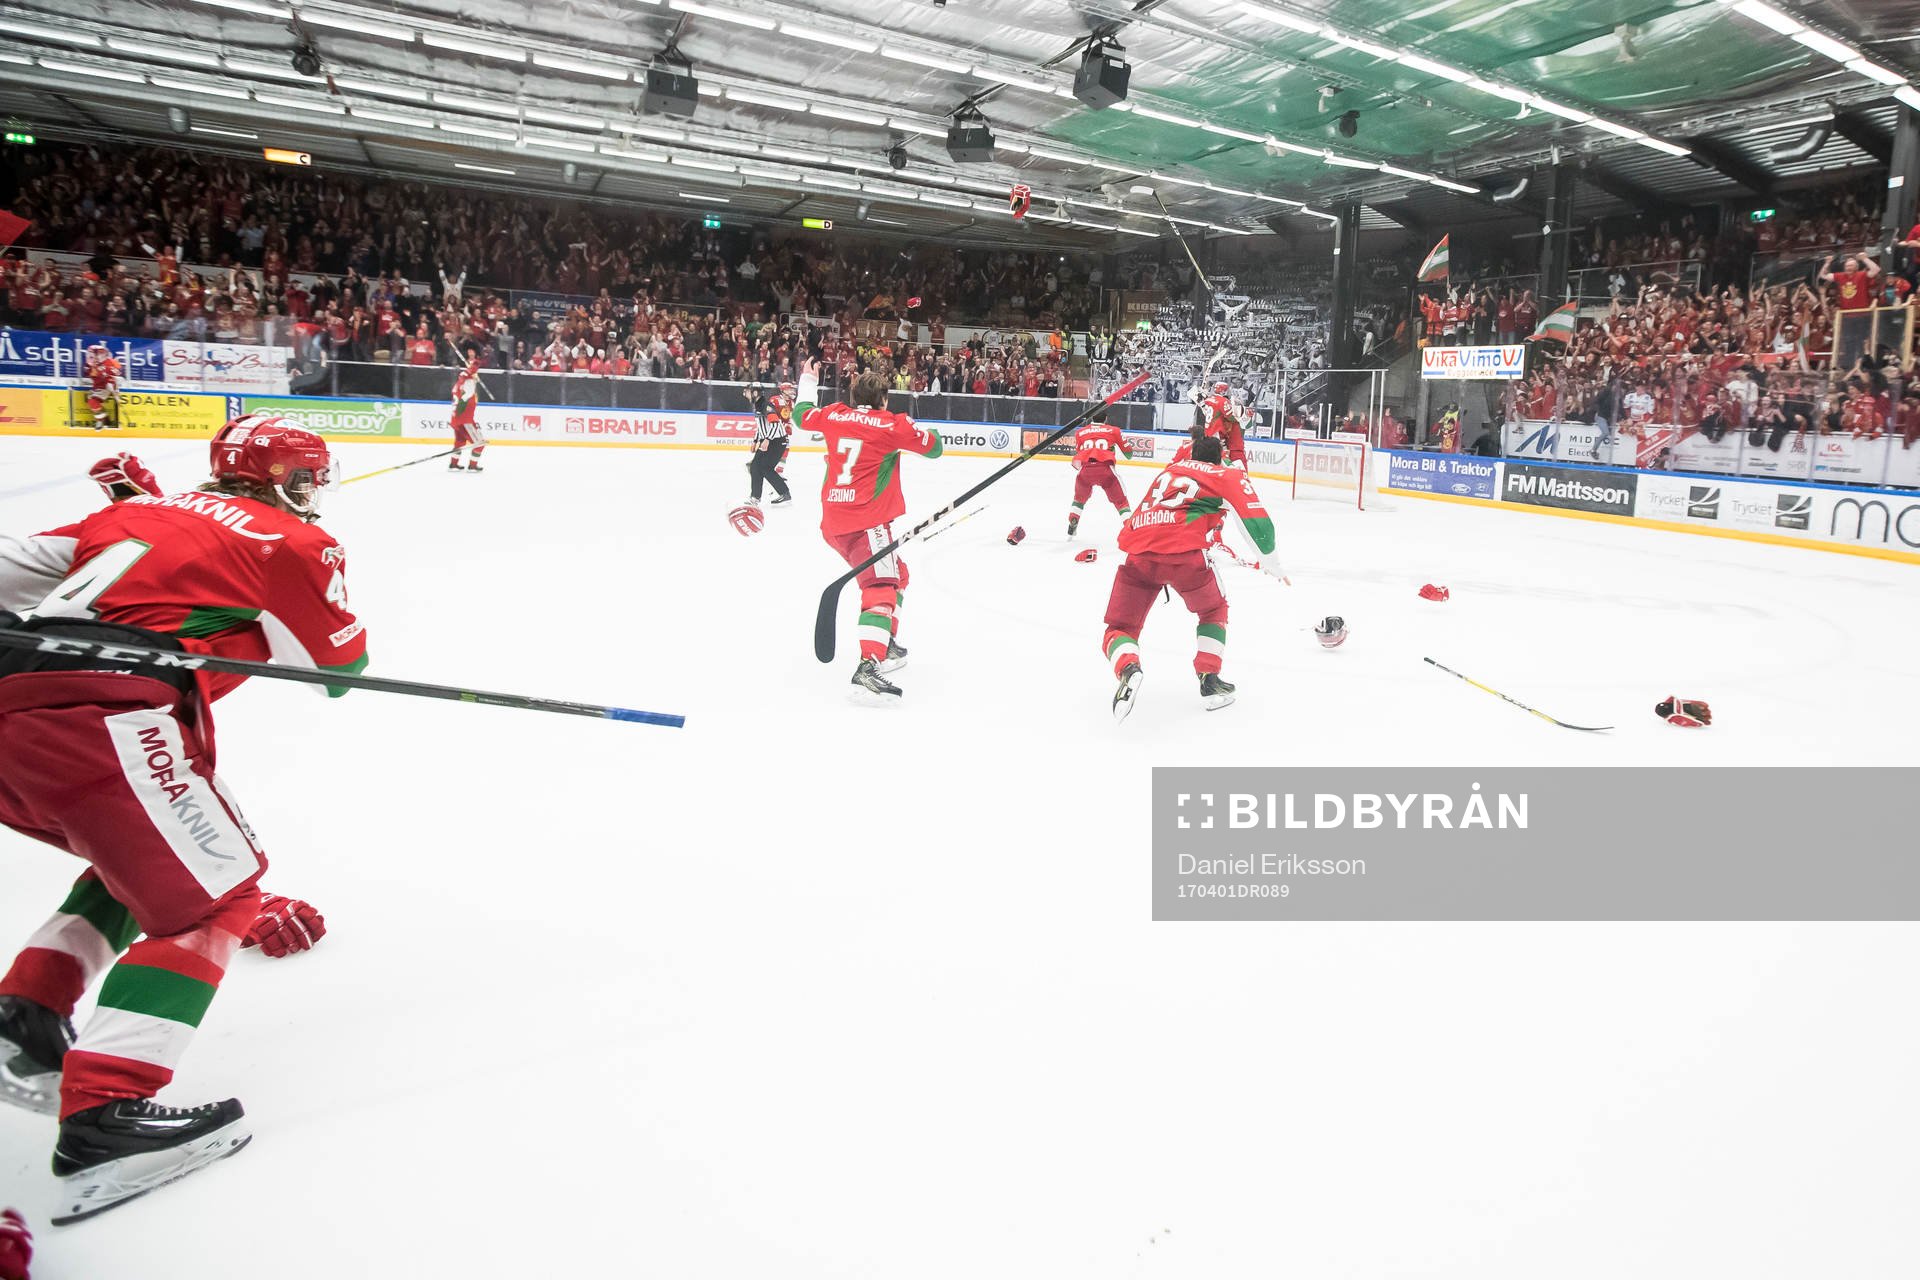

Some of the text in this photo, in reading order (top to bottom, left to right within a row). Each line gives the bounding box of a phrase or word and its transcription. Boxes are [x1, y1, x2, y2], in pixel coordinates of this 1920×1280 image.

[299, 154, 308, 164] C
[824, 221, 831, 229] D
[1127, 302, 1161, 311] KIOS
[487, 422, 517, 431] SPEL
[714, 419, 758, 431] CC
[941, 433, 986, 447] metro
[1569, 434, 1620, 446] MIDOC
[227, 451, 236, 465] 4
[837, 438, 864, 485] 7
[1245, 449, 1288, 465] AKNIV
[1392, 456, 1493, 476] Mora Bil & Traktor
[1141, 471, 1201, 512] 32
[1537, 476, 1630, 505] Mattsson
[1649, 492, 1685, 507] Trycket
[1732, 499, 1772, 516] Trycket
[22, 538, 153, 622] 4
[326, 569, 347, 611] 4
[37, 636, 208, 670] CCM
[137, 726, 238, 862] MORAKNIV
